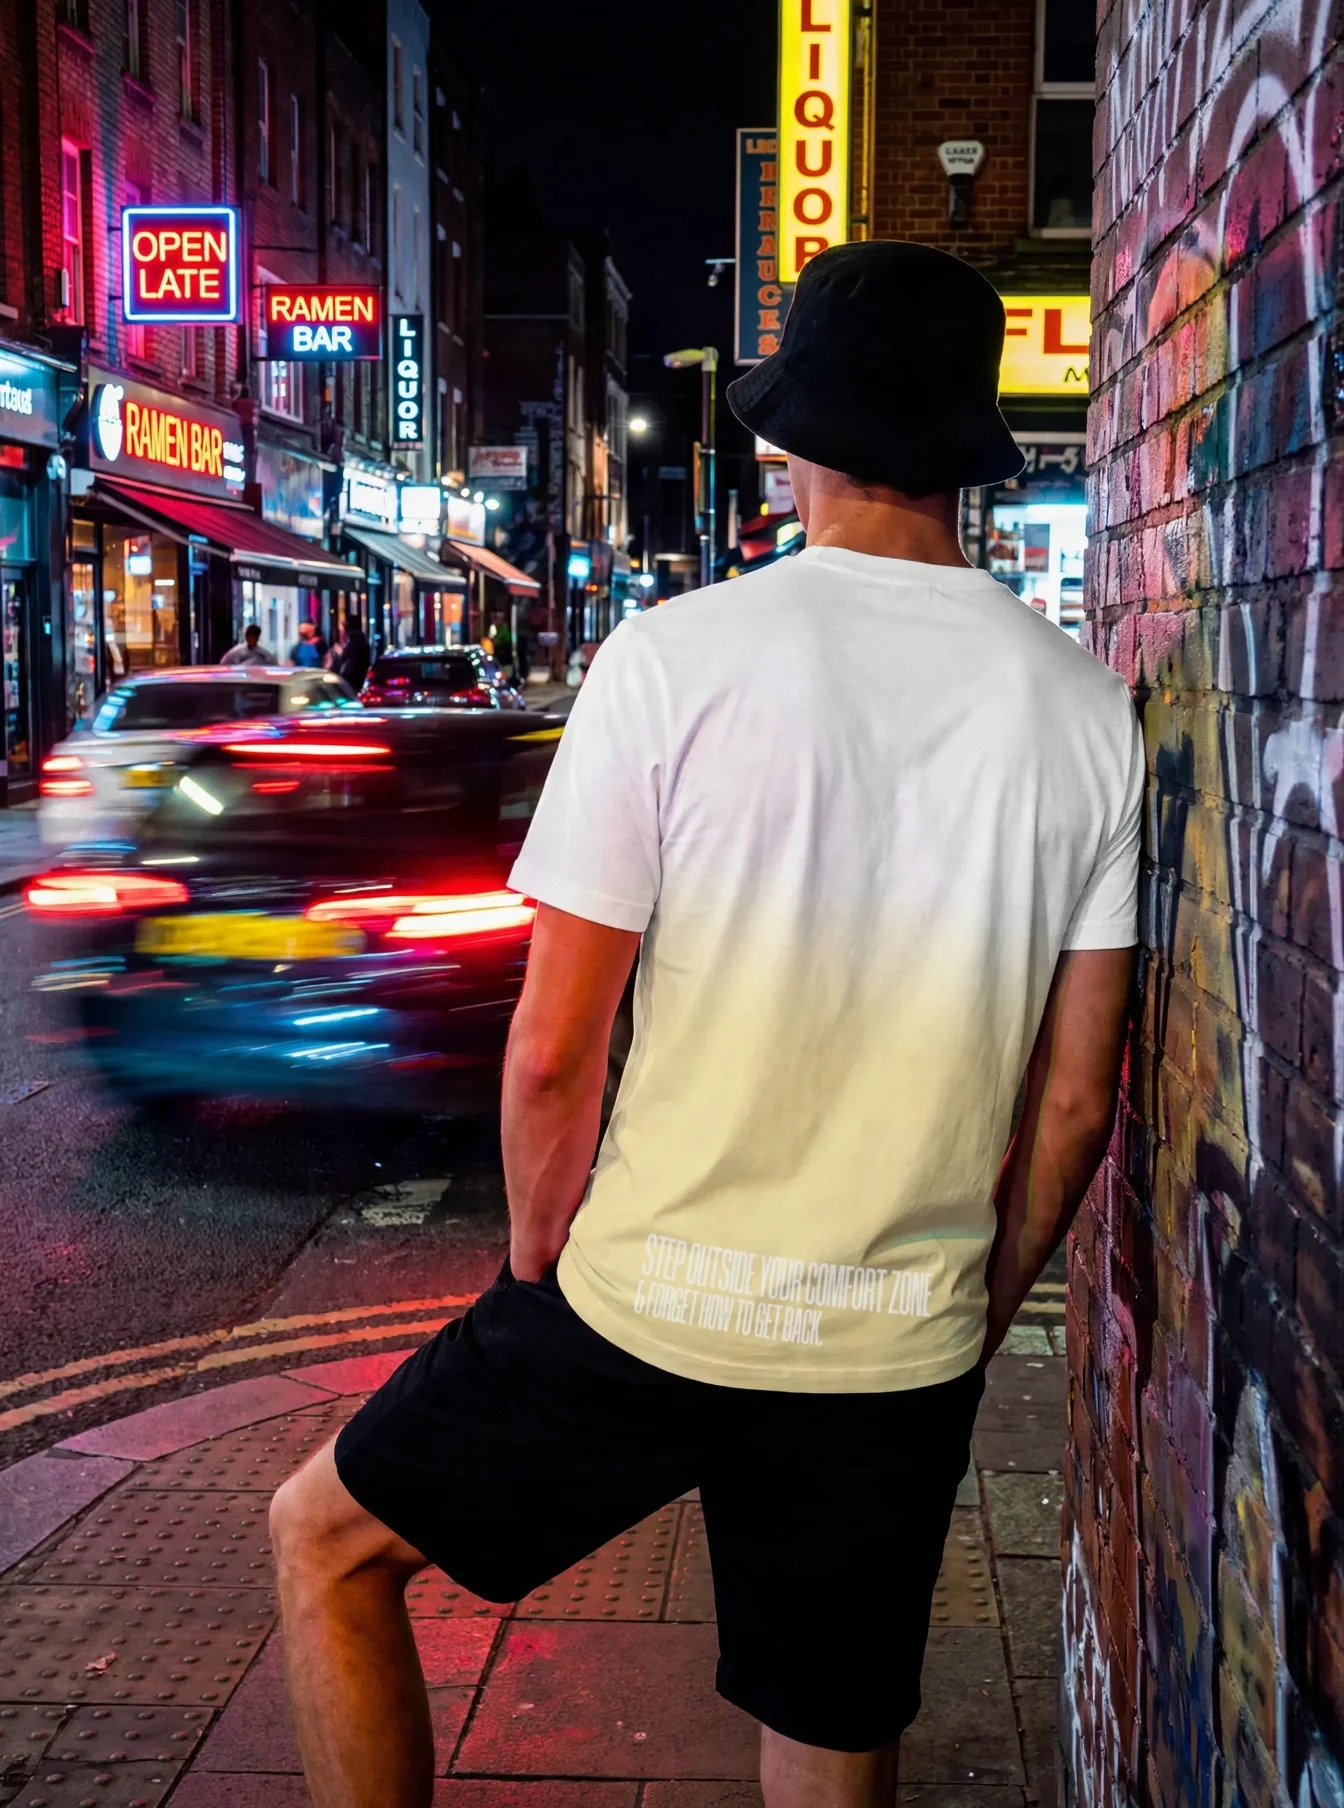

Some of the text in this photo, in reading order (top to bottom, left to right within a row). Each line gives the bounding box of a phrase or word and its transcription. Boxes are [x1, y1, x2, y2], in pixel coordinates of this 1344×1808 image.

[132, 231, 227, 262] OPEN
[139, 268, 220, 299] LATE
[271, 296, 373, 322] RAMEN
[293, 326, 353, 352] BAR
[397, 318, 419, 439] LIQUOR
[126, 402, 222, 477] RAMEN BAR
[641, 1233, 934, 1317] STEP OUTSIDE YOUR COMFORT ZONE
[645, 1281, 700, 1326] FORGET
[698, 1292, 734, 1332] HOW
[734, 1299, 754, 1336] TO
[754, 1303, 783, 1340] GET
